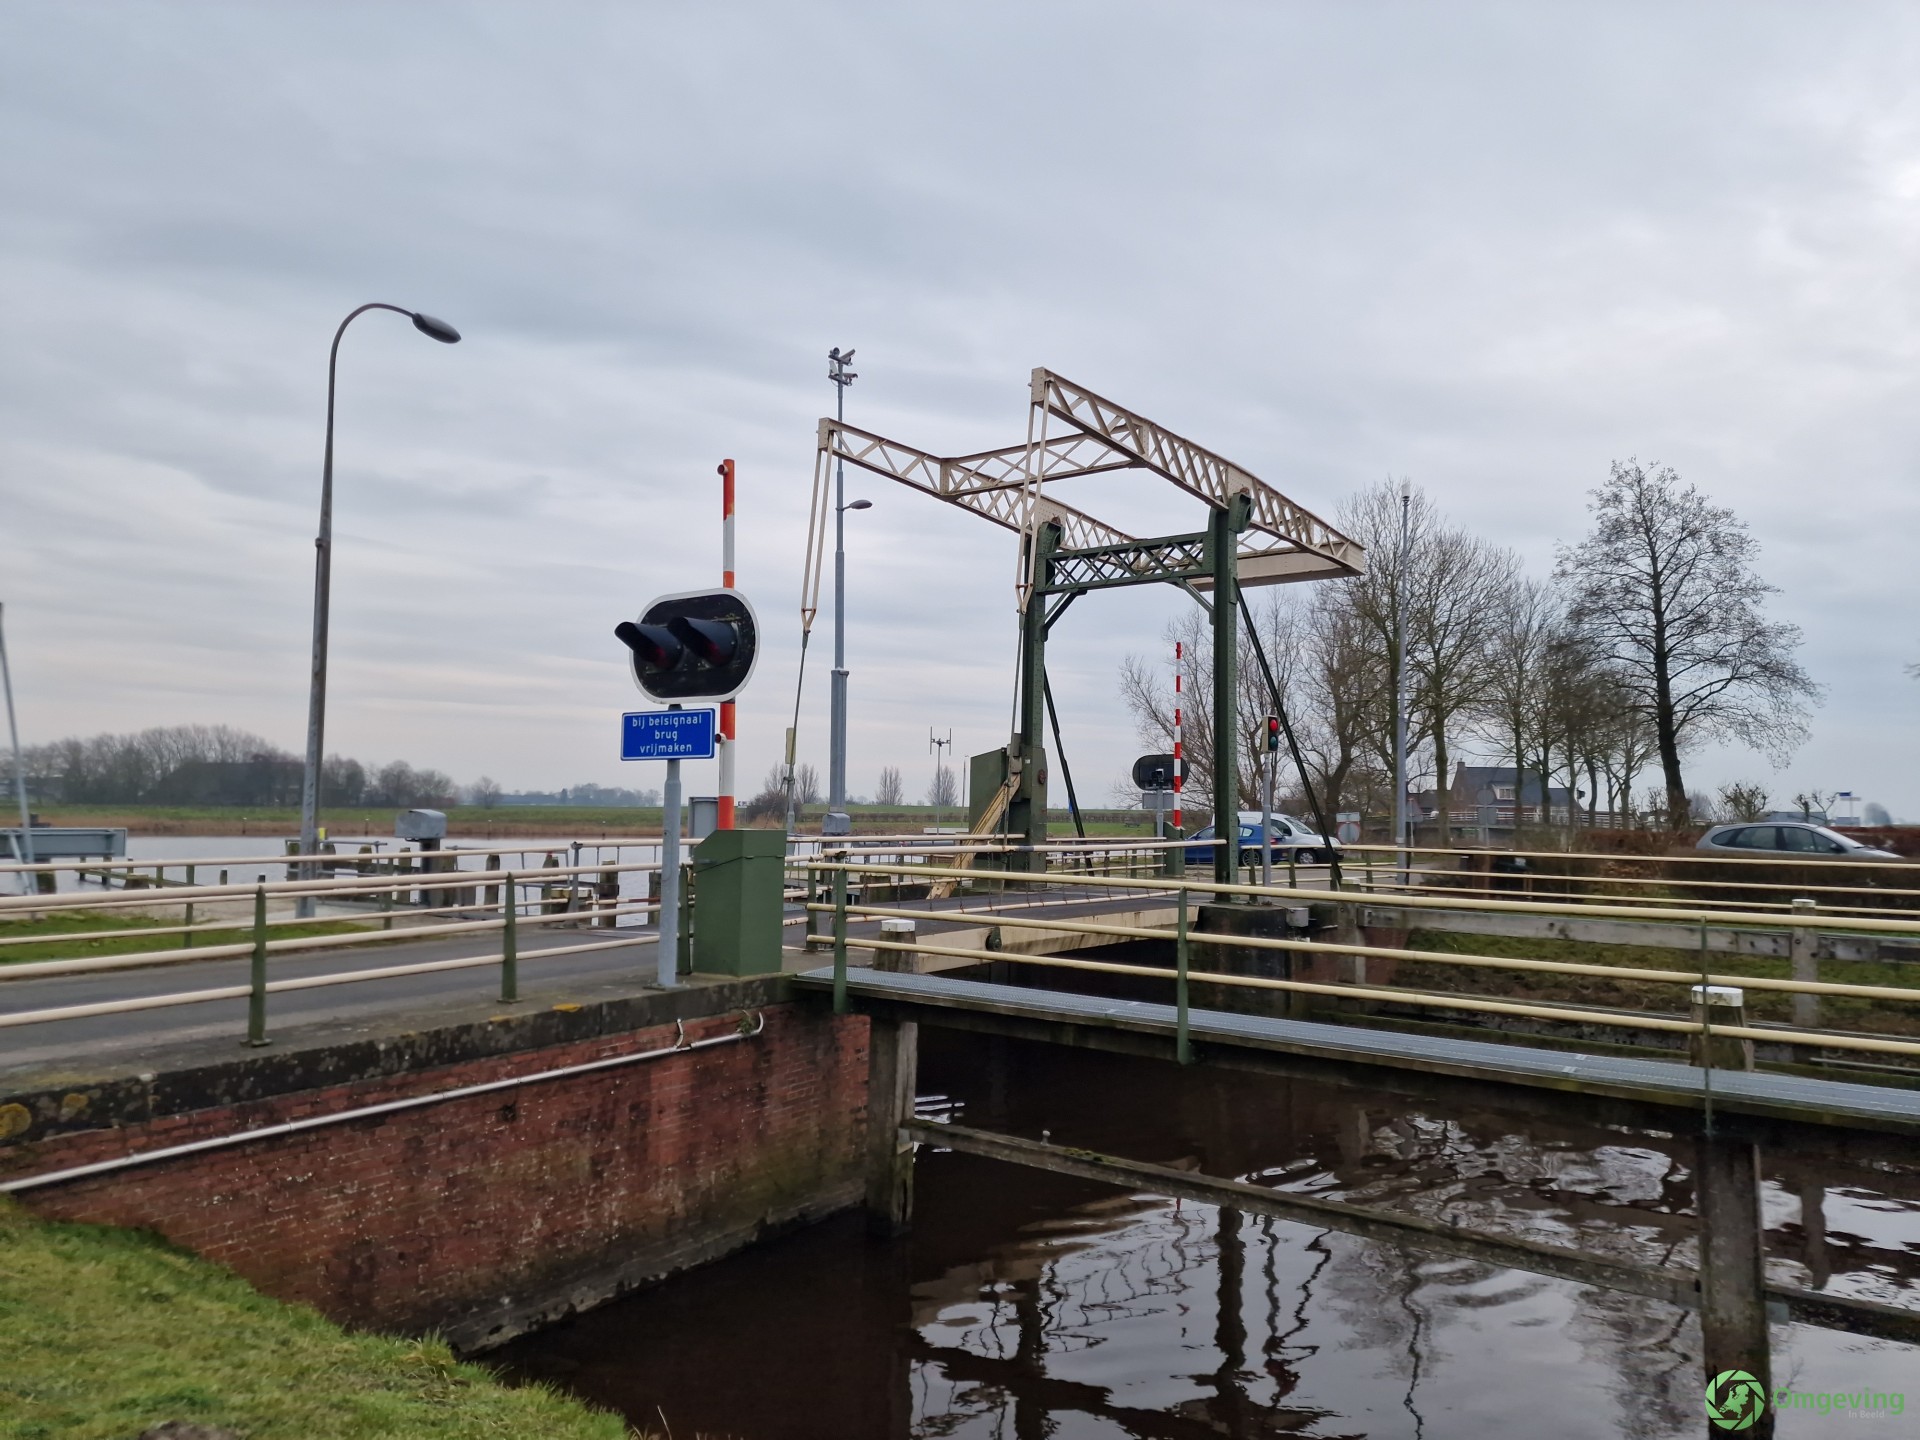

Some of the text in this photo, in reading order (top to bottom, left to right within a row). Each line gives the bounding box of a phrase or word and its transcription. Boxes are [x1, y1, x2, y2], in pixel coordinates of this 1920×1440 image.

[632, 714, 702, 729] bij belsignaal
[654, 730, 678, 741] brug
[640, 743, 692, 756] vrijmaken
